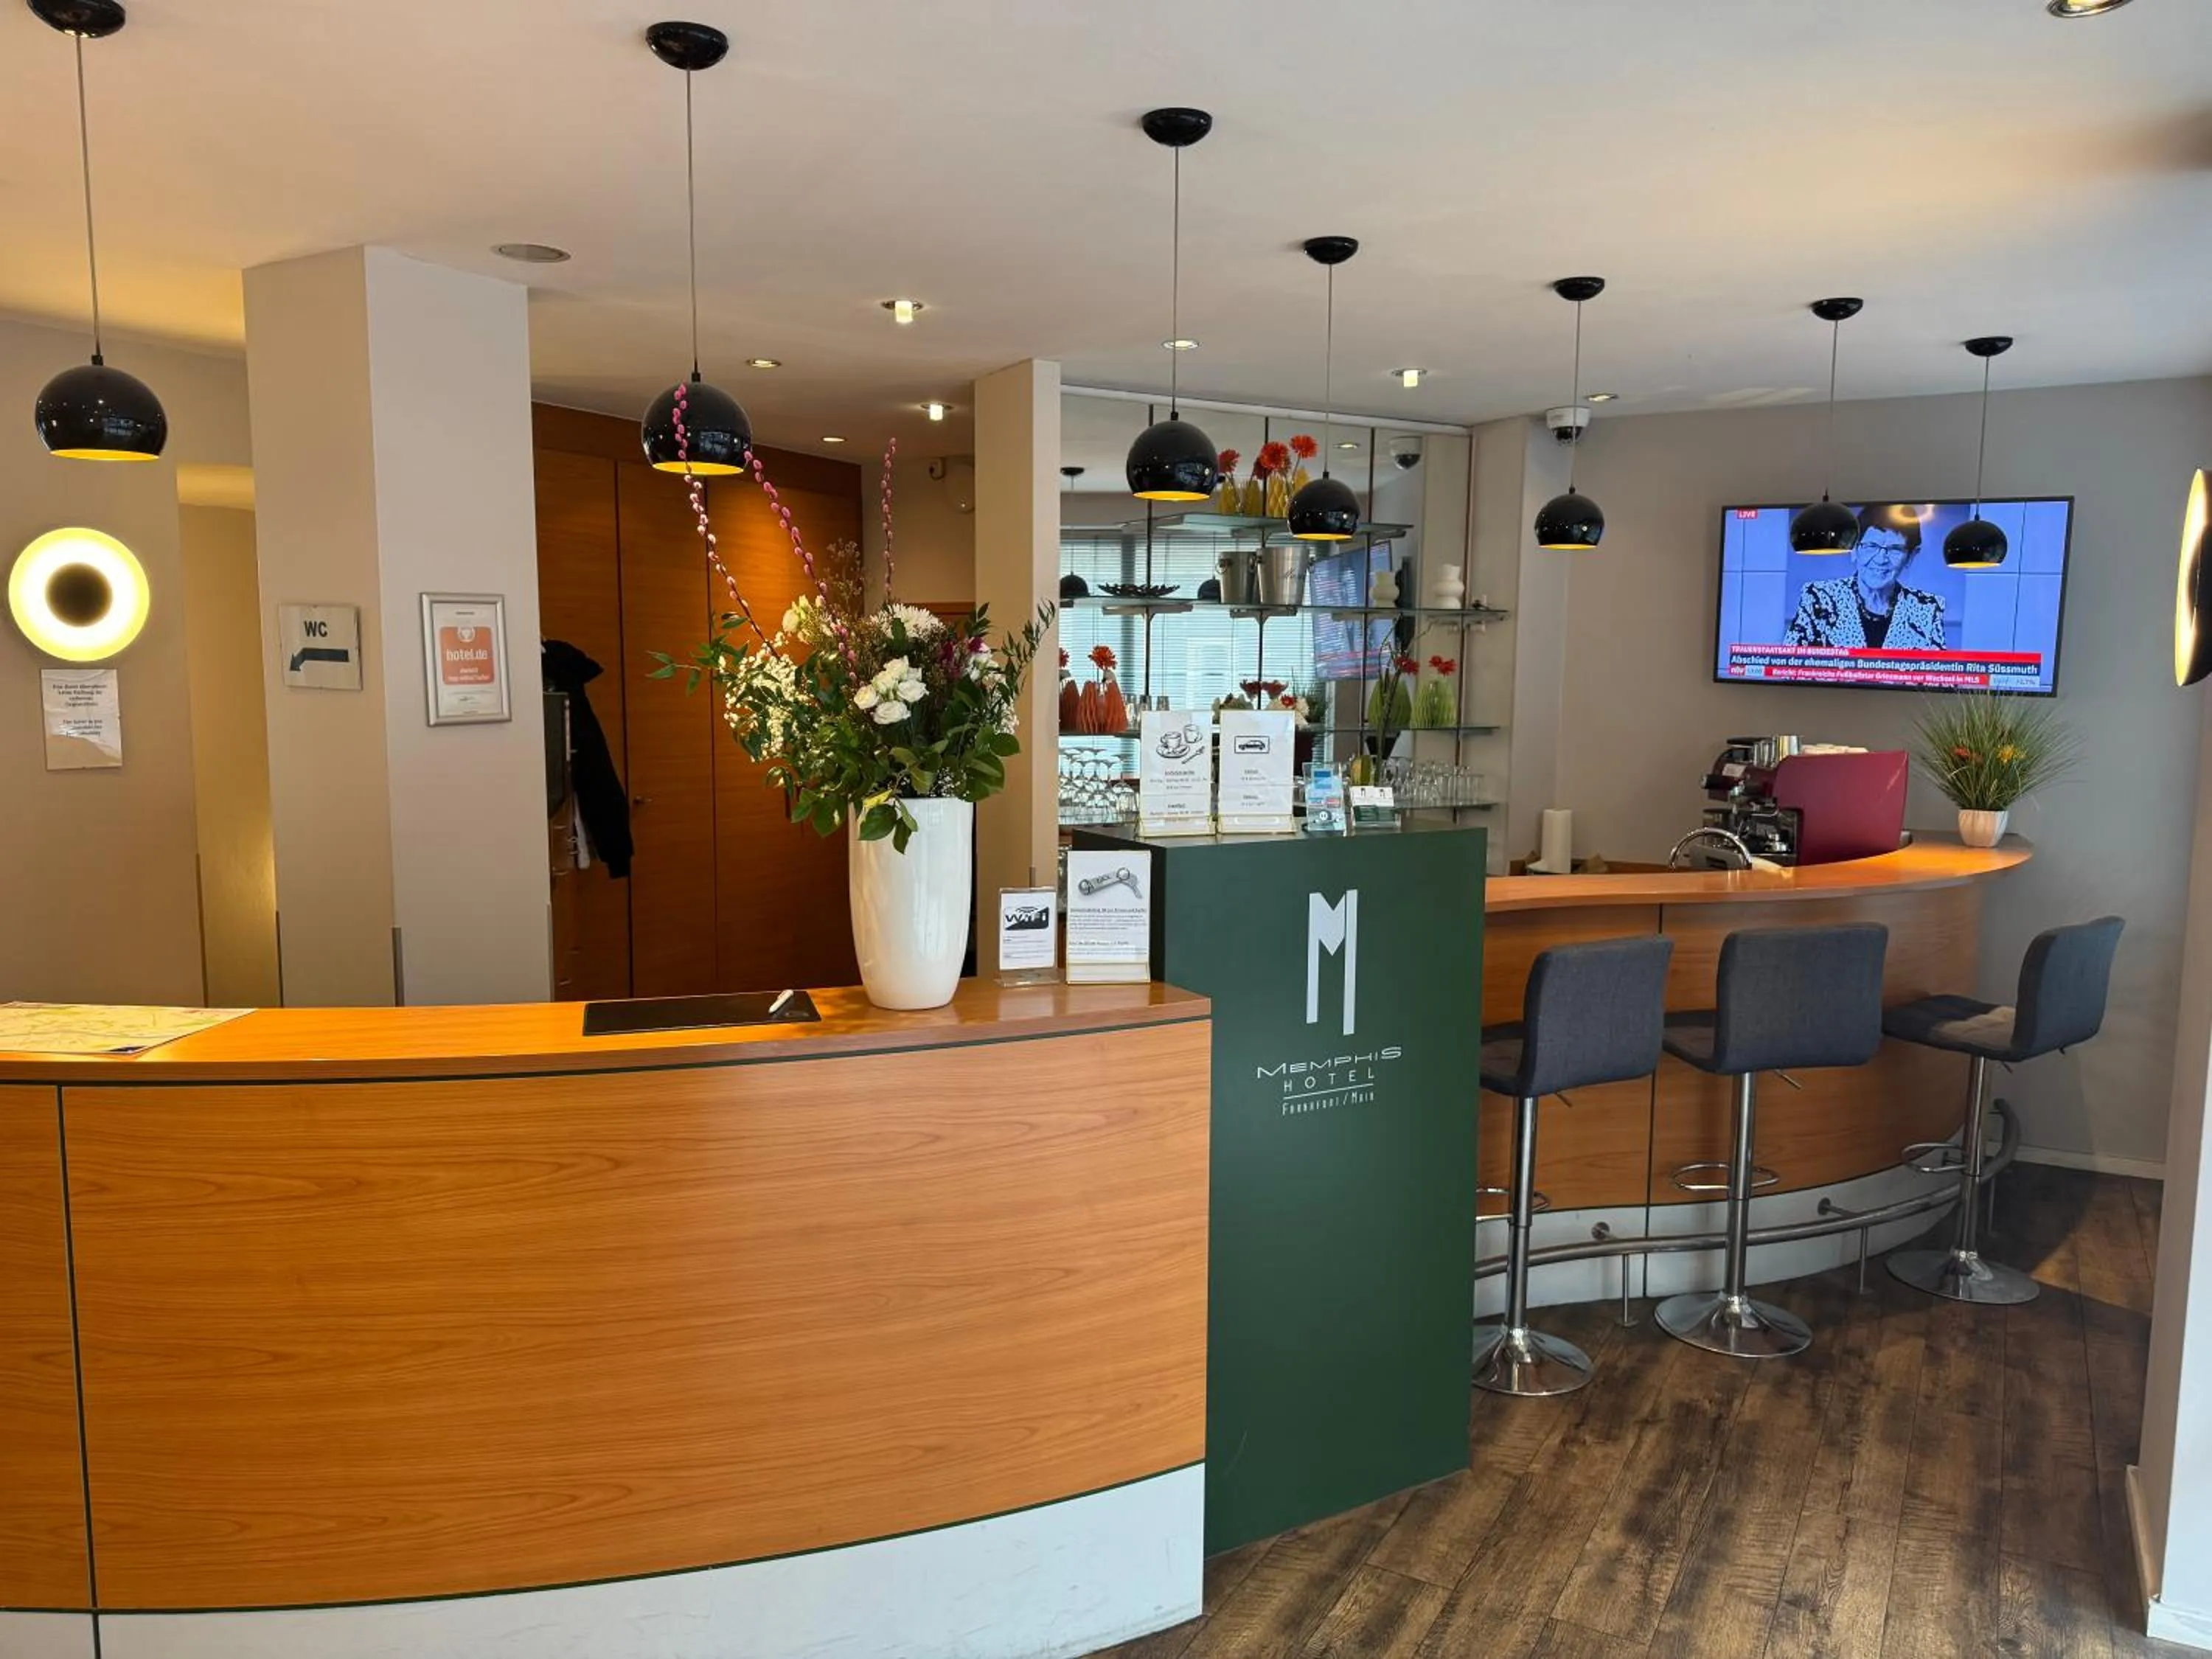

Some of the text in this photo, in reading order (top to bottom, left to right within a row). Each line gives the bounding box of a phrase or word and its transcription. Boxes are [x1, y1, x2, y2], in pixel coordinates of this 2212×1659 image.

[304, 620, 328, 637] WC
[446, 649, 487, 661] hotel.de
[1731, 655, 1769, 665] Abschied
[1792, 657, 1804, 666] der
[1804, 657, 1855, 669] ehemaligen
[1857, 659, 1964, 672] Bundestagspräsidentin
[1966, 664, 1986, 673] Rita
[1988, 664, 2037, 675] Süssmuth
[1257, 1047, 1402, 1079] MEMPHIS
[1284, 1067, 1374, 1093] HOTEL
